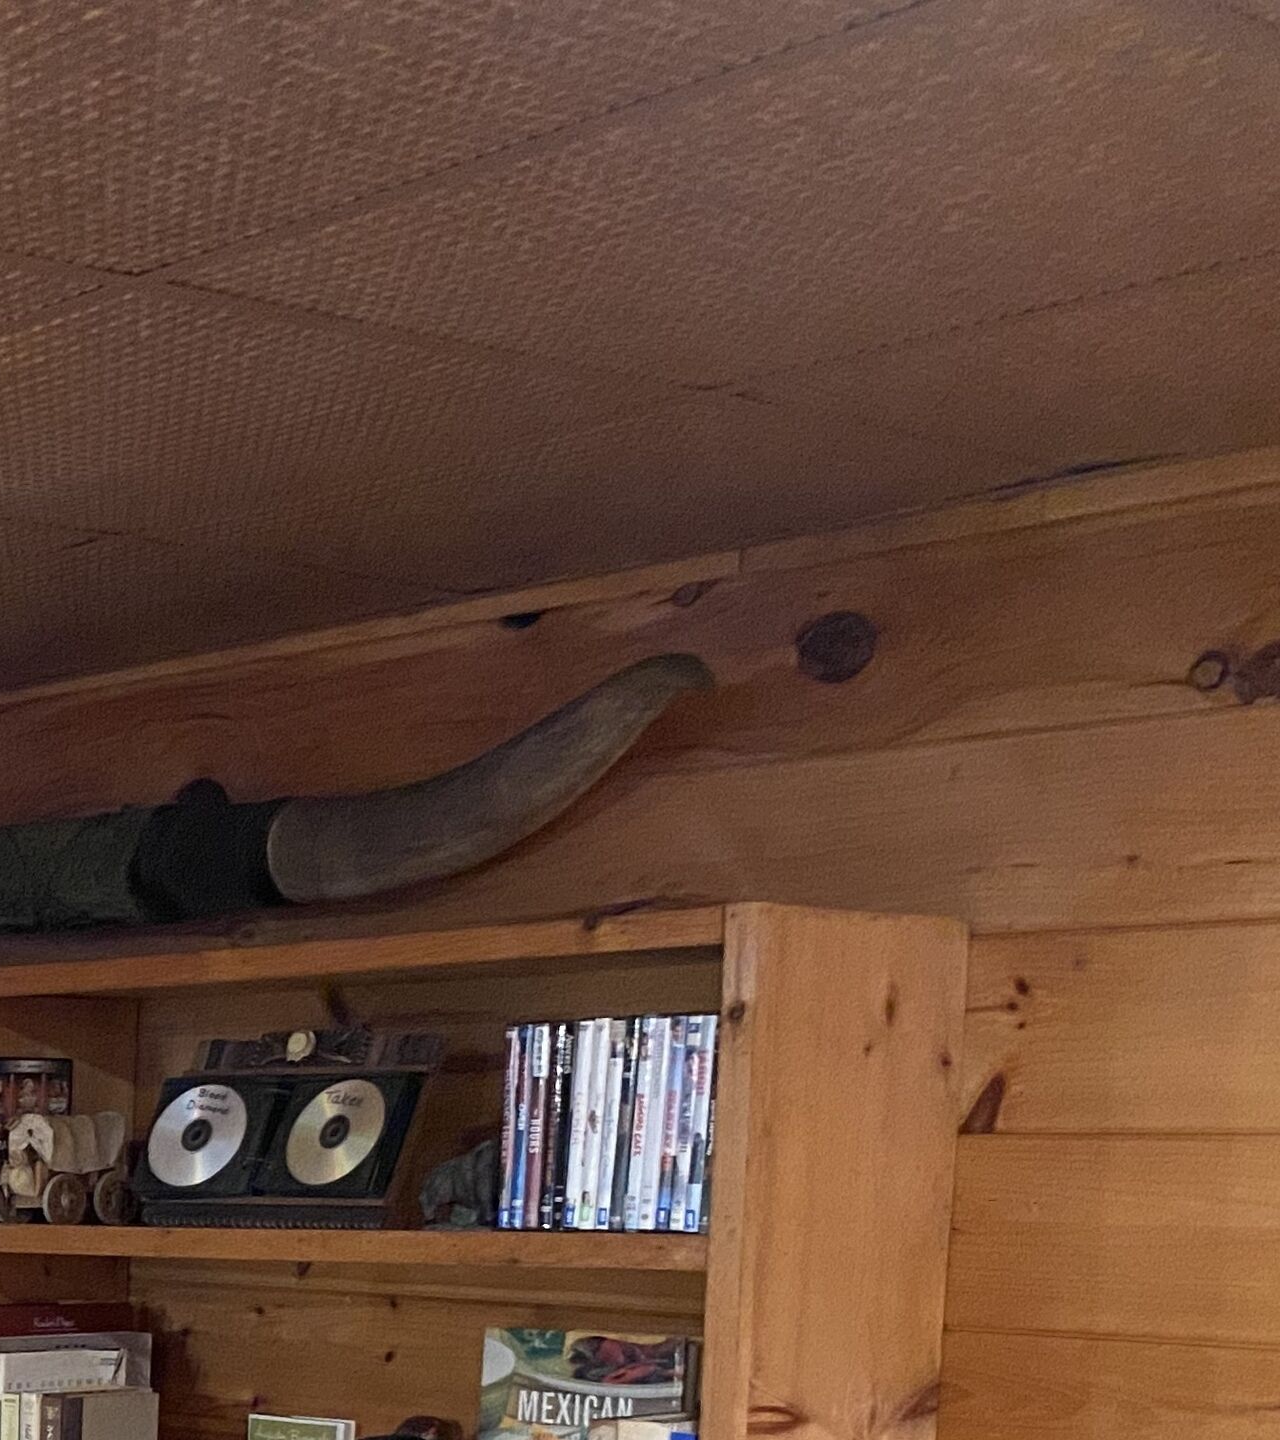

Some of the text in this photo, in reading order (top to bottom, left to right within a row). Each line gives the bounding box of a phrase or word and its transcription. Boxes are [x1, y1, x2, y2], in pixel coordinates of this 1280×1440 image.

[198, 1088, 227, 1101] Blood
[324, 1090, 363, 1108] Taken
[186, 1100, 229, 1115] Diamond
[528, 1119, 540, 1154] HOURS
[517, 1390, 634, 1428] MEXICAN
